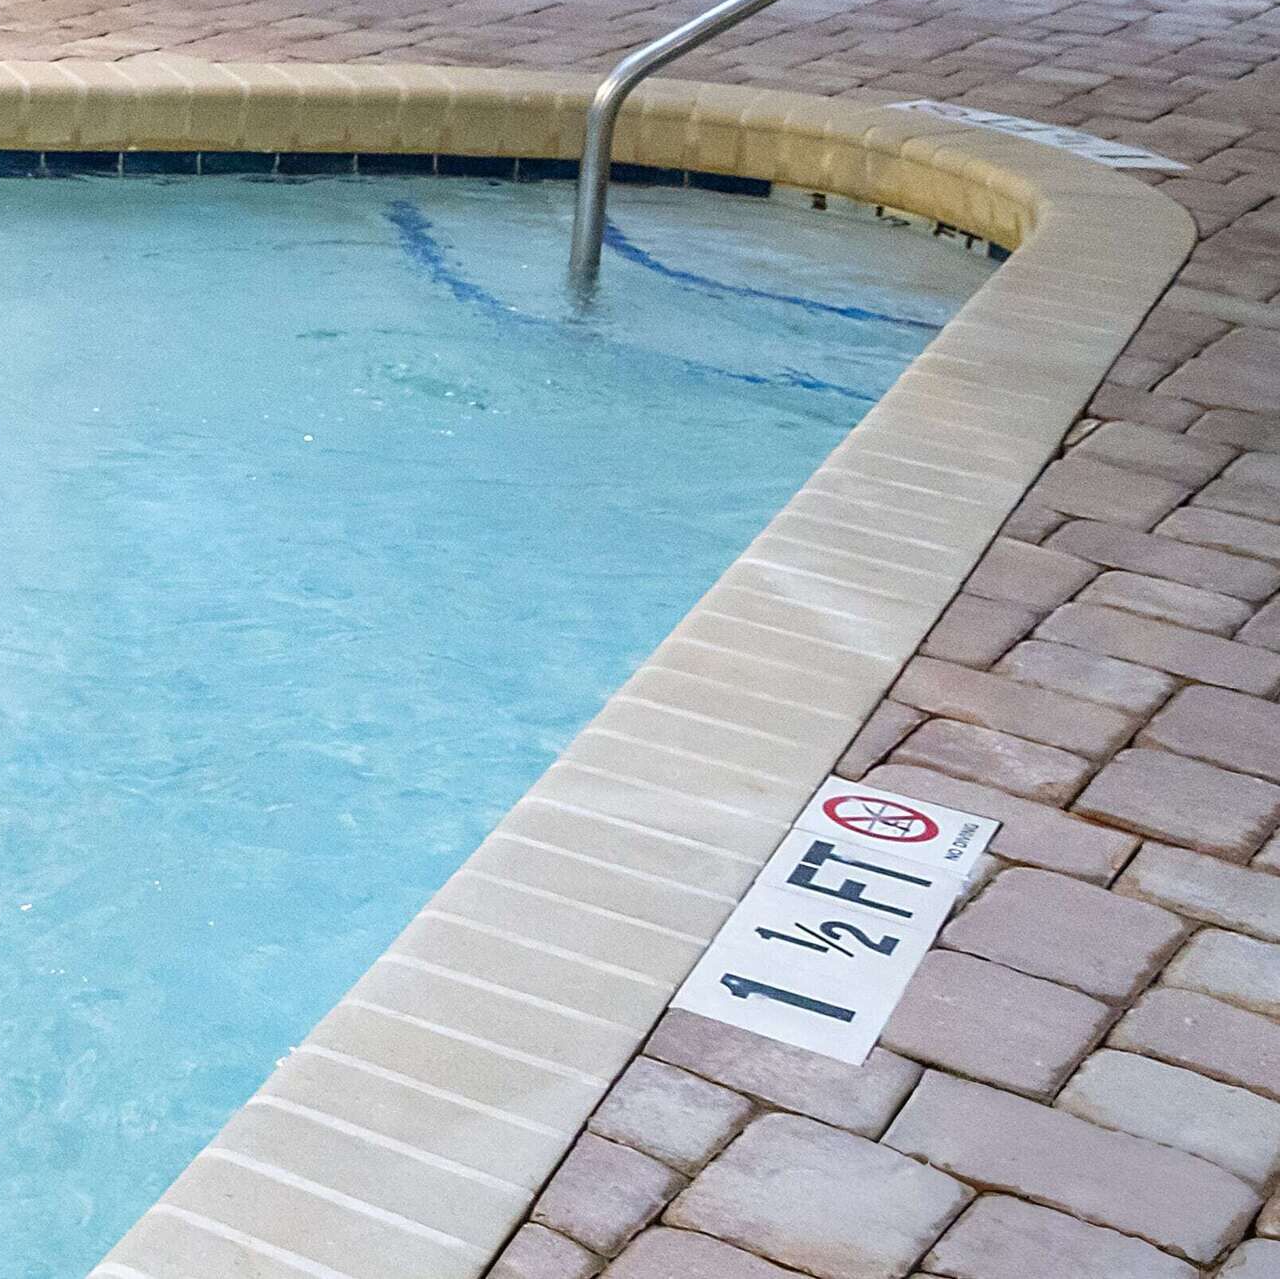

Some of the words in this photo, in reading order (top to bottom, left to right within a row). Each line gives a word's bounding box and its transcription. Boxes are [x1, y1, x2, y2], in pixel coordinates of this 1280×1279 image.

[786, 839, 933, 919] FT
[944, 848, 964, 861] NO
[720, 972, 857, 1024] 1
